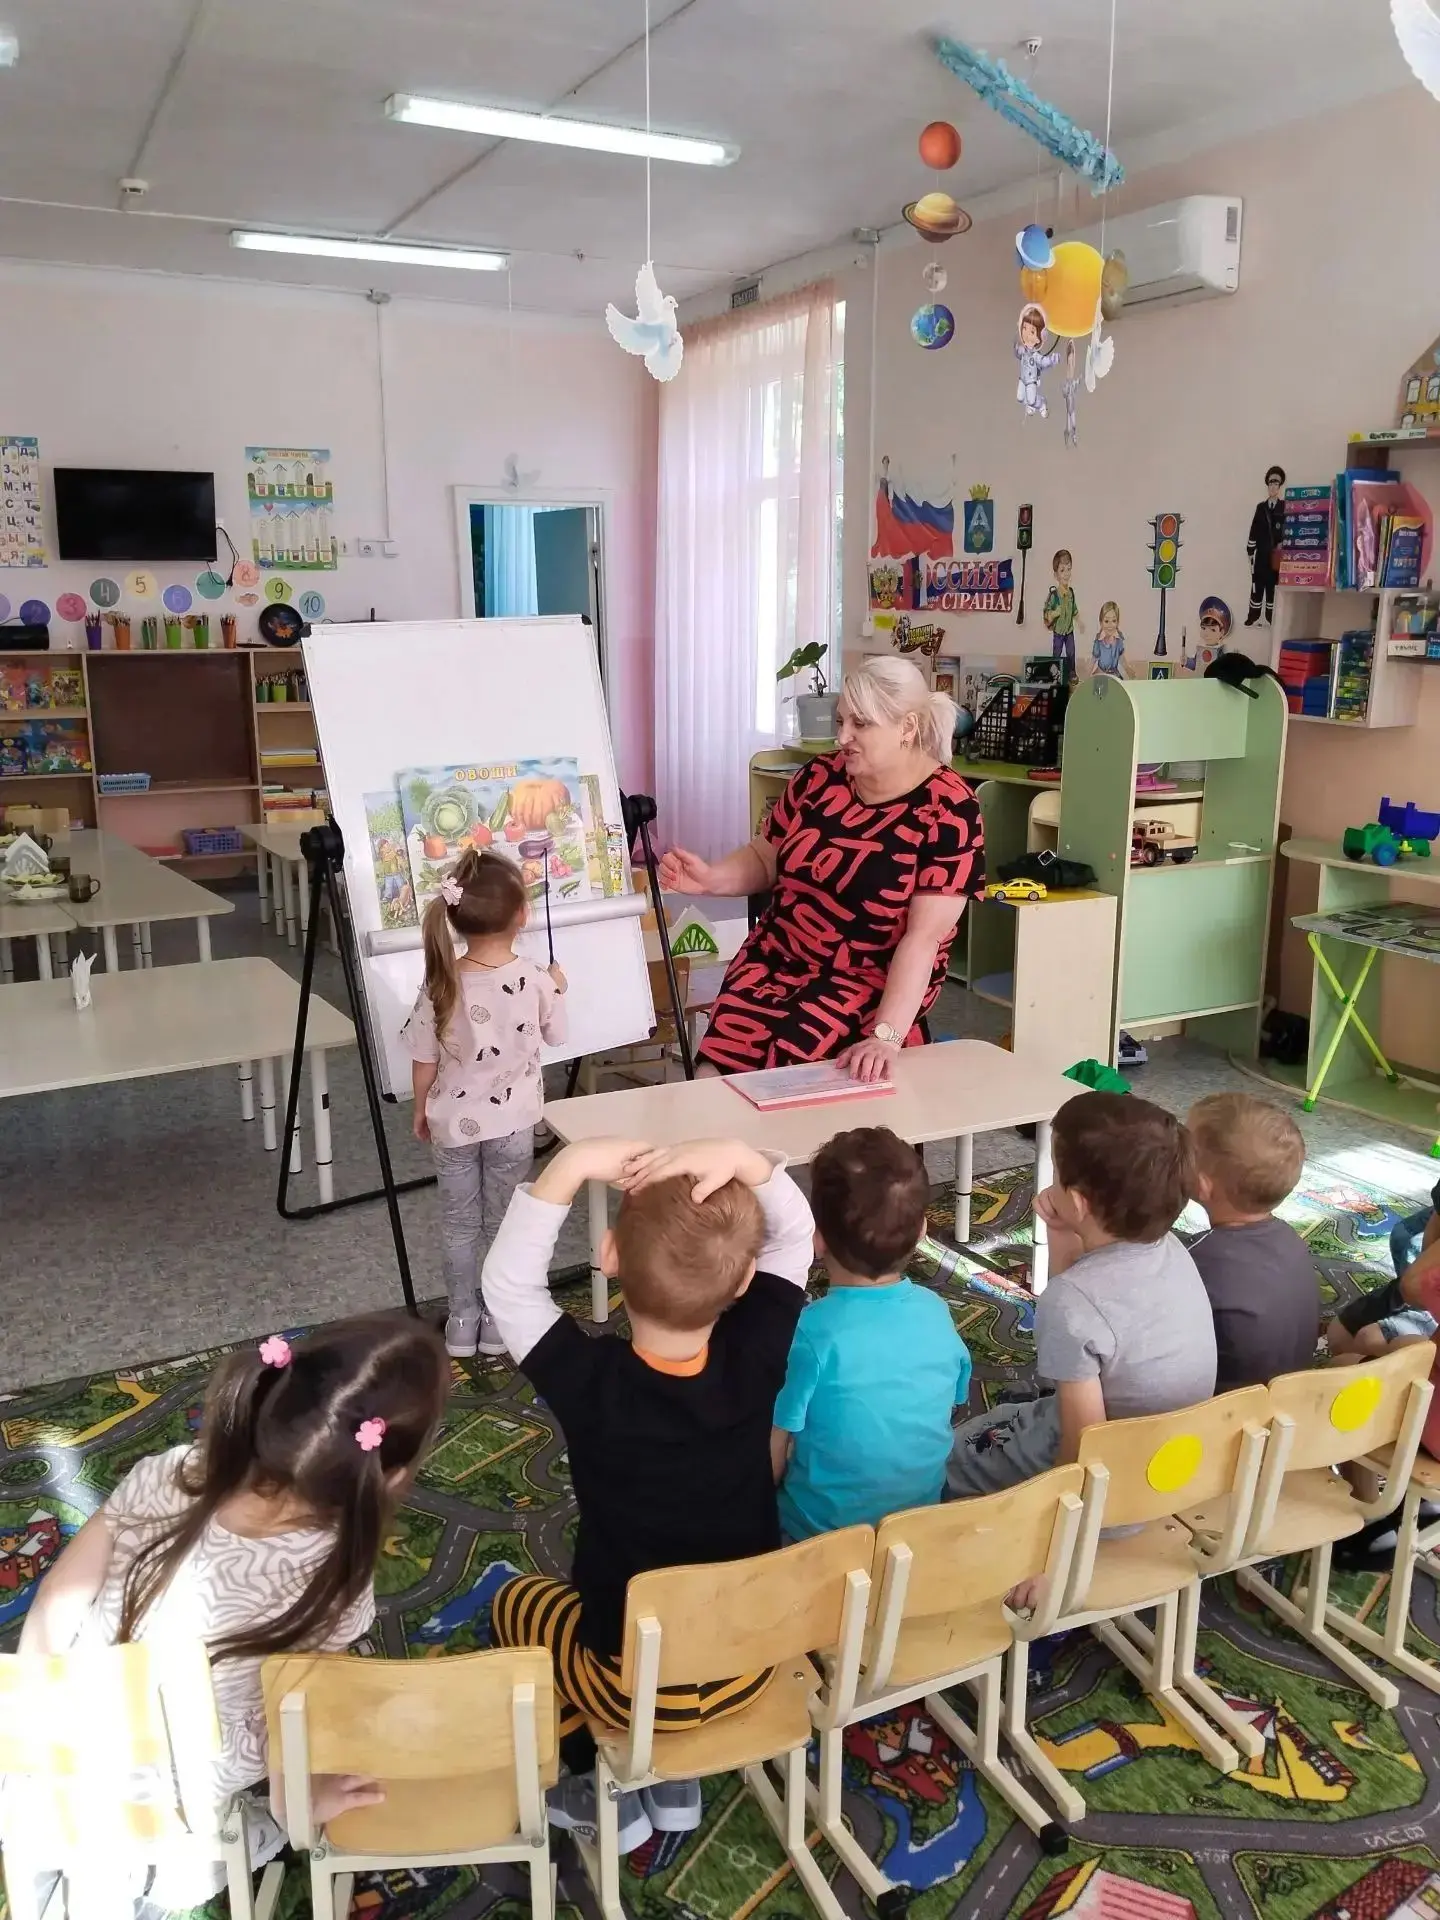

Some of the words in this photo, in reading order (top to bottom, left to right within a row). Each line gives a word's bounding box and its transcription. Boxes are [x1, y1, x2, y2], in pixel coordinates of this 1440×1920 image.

[913, 560, 1007, 590] ССИЯ-
[100, 582, 111, 602] 4
[135, 576, 147, 594] 5
[274, 582, 284, 599] 9
[65, 598, 78, 616] 3
[304, 595, 321, 614] 10
[942, 592, 1012, 611] СТРАНА!
[455, 765, 517, 781] ОВОЩИ
[1192, 1850, 1231, 1863] STOP
